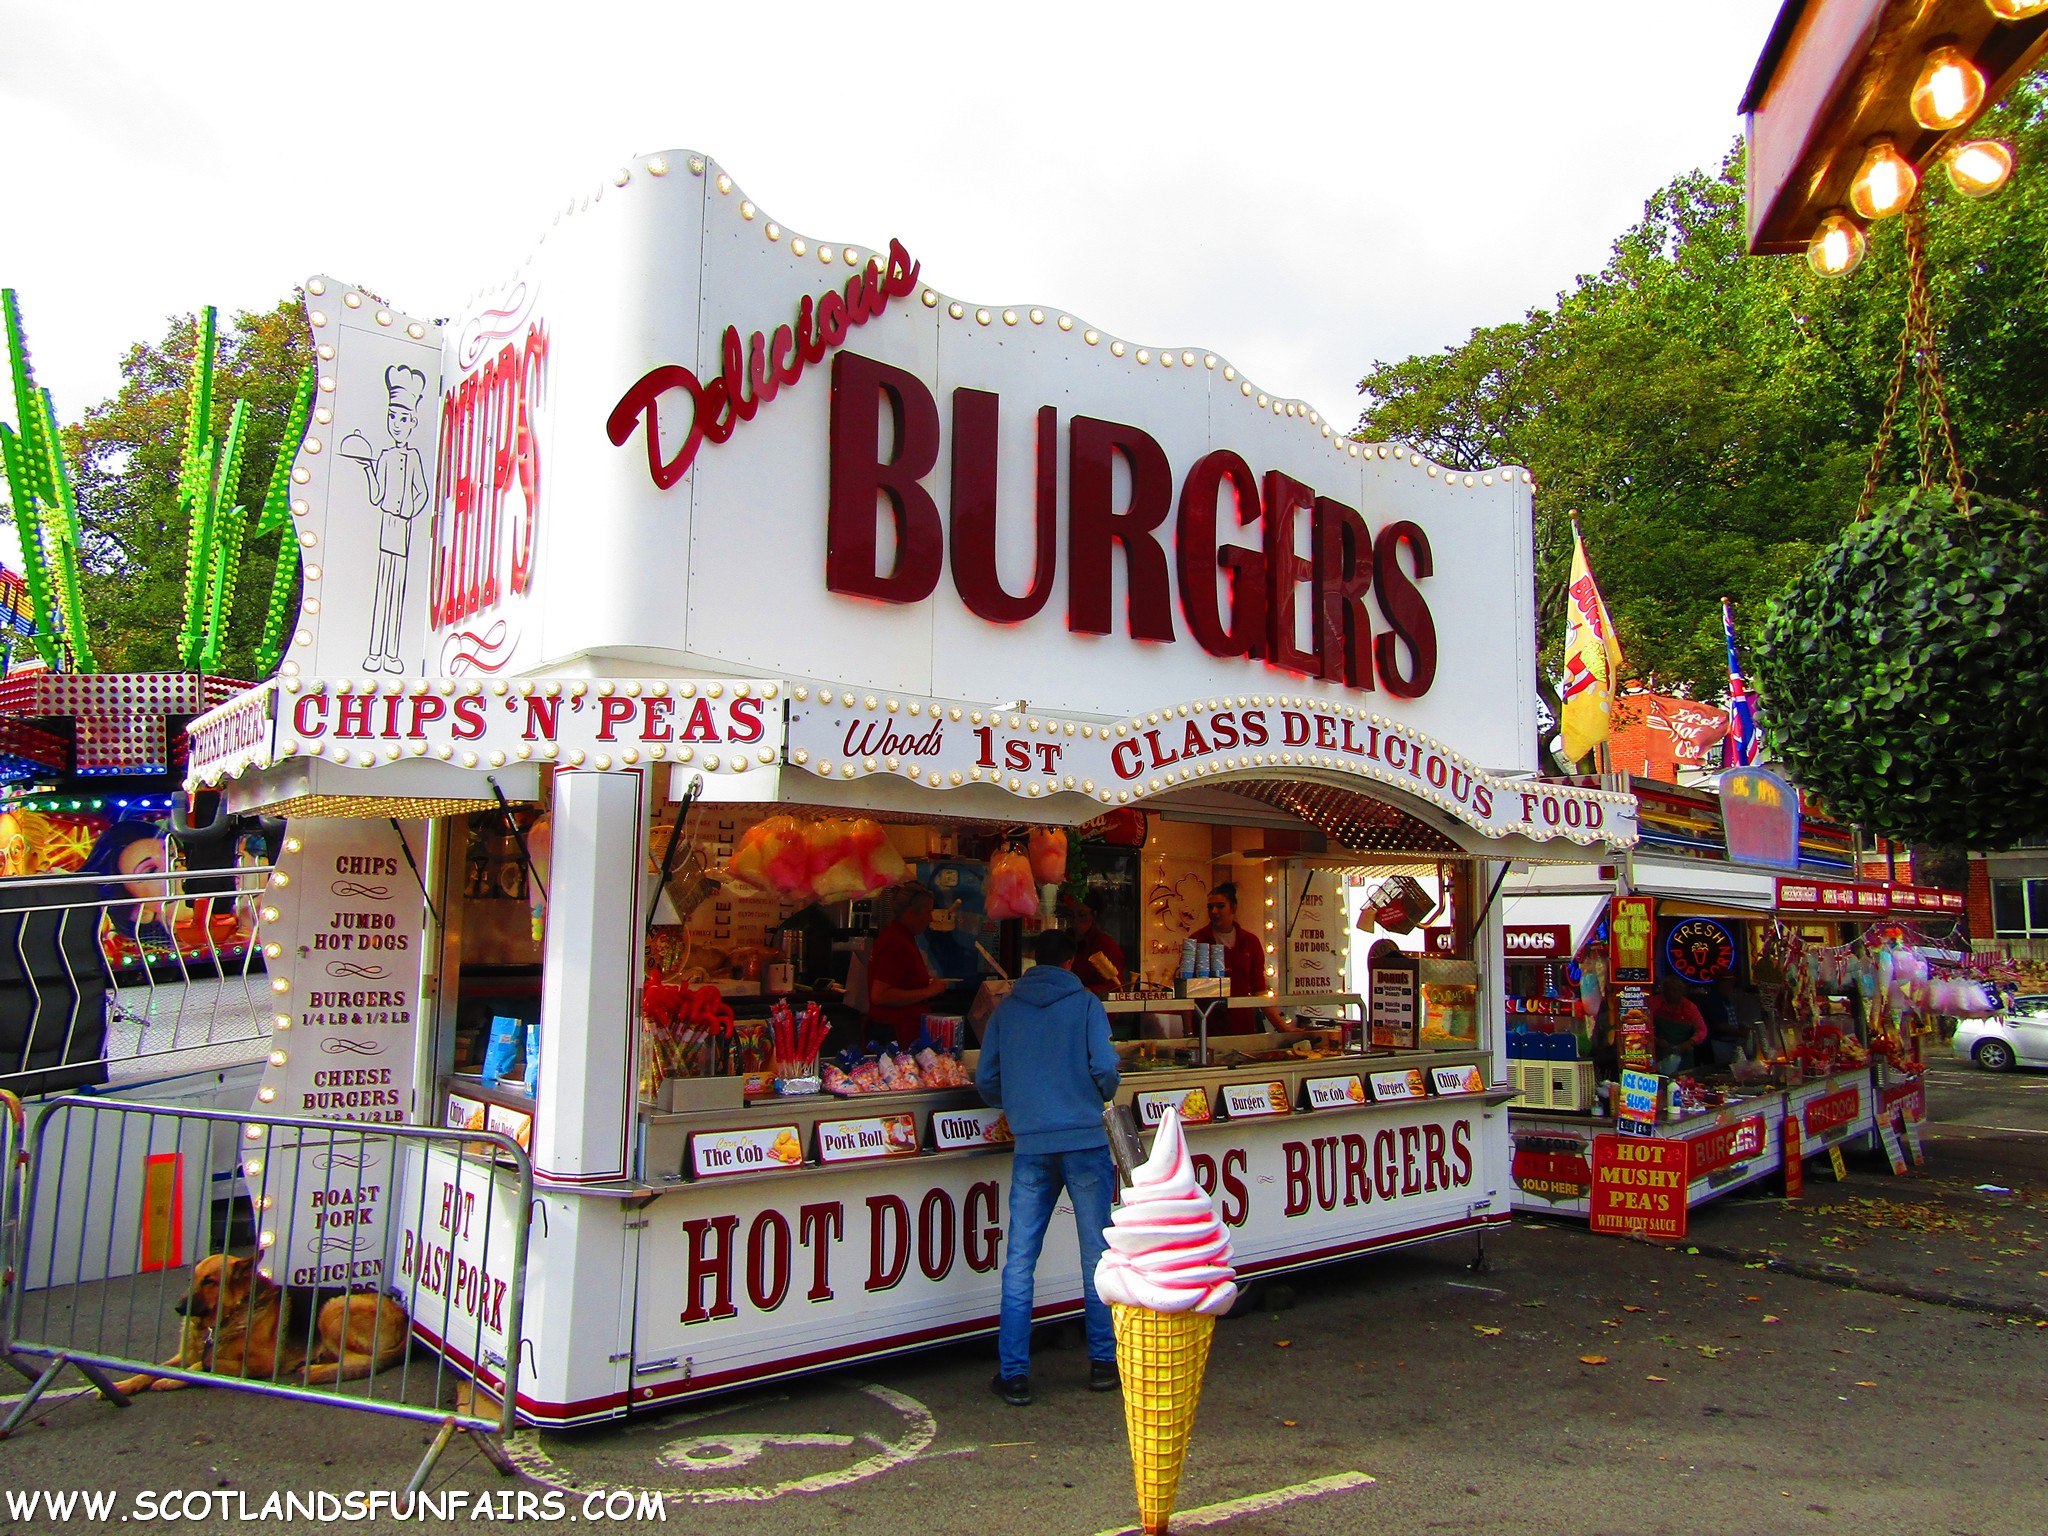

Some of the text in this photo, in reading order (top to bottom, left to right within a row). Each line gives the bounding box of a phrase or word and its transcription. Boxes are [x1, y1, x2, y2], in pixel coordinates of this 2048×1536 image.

[606, 237, 920, 490] Delicious
[826, 350, 1438, 700] BURGERS
[293, 693, 488, 741] CHIPS
[595, 696, 765, 743] PEAS
[973, 726, 1063, 775] 1ST
[1110, 709, 1270, 782] CLASS
[1280, 709, 1494, 820] DELICIOUS
[1520, 791, 1605, 830] FOOD
[336, 855, 398, 876] CHIPS
[330, 912, 396, 929] JUMBO
[314, 933, 409, 950] HOT DOGS
[1300, 929, 1325, 940] JUMBO
[1506, 932, 1555, 949] DOGS
[1673, 922, 1726, 944] FRESH
[1295, 976, 1331, 988] BURGERS
[310, 991, 406, 1008] BURGERS
[1115, 992, 1168, 1000] ICE CREAM
[1505, 1000, 1561, 1014] SLUSH
[302, 1011, 411, 1026] 1/4 LB & 1/2 LB
[315, 1069, 392, 1087] CHEESE
[1435, 1073, 1461, 1088] Chips
[1623, 1073, 1657, 1093] ICE COLD
[303, 1090, 400, 1110] BURGERS
[1313, 1087, 1345, 1103] The Cob
[1377, 1083, 1406, 1097] Burgers
[1232, 1096, 1265, 1111] Burgers
[1626, 1093, 1652, 1112] SLUSH
[385, 1110, 404, 1122] LB
[450, 1101, 464, 1126] Chips
[941, 1117, 980, 1140] Chips
[825, 1130, 883, 1151] Pork Roll
[1545, 1138, 1577, 1150] COLD
[703, 1145, 763, 1167] The Cob
[1616, 1143, 1666, 1163] HOT
[1282, 1119, 1472, 1217] BURGERS
[1599, 1166, 1681, 1188] MUSHY
[311, 1186, 380, 1208] ROAST
[1523, 1178, 1579, 1196] SOLD HERE
[1608, 1190, 1670, 1212] PEA'S
[315, 1208, 374, 1229] PORK
[439, 1182, 476, 1241] HOT
[1597, 1214, 1677, 1231] WITH MINT SAUCE
[680, 1201, 843, 1325] HOT
[865, 1180, 1003, 1294] DOG
[294, 1259, 384, 1286] CHICKEN
[454, 1258, 507, 1335] PORK
